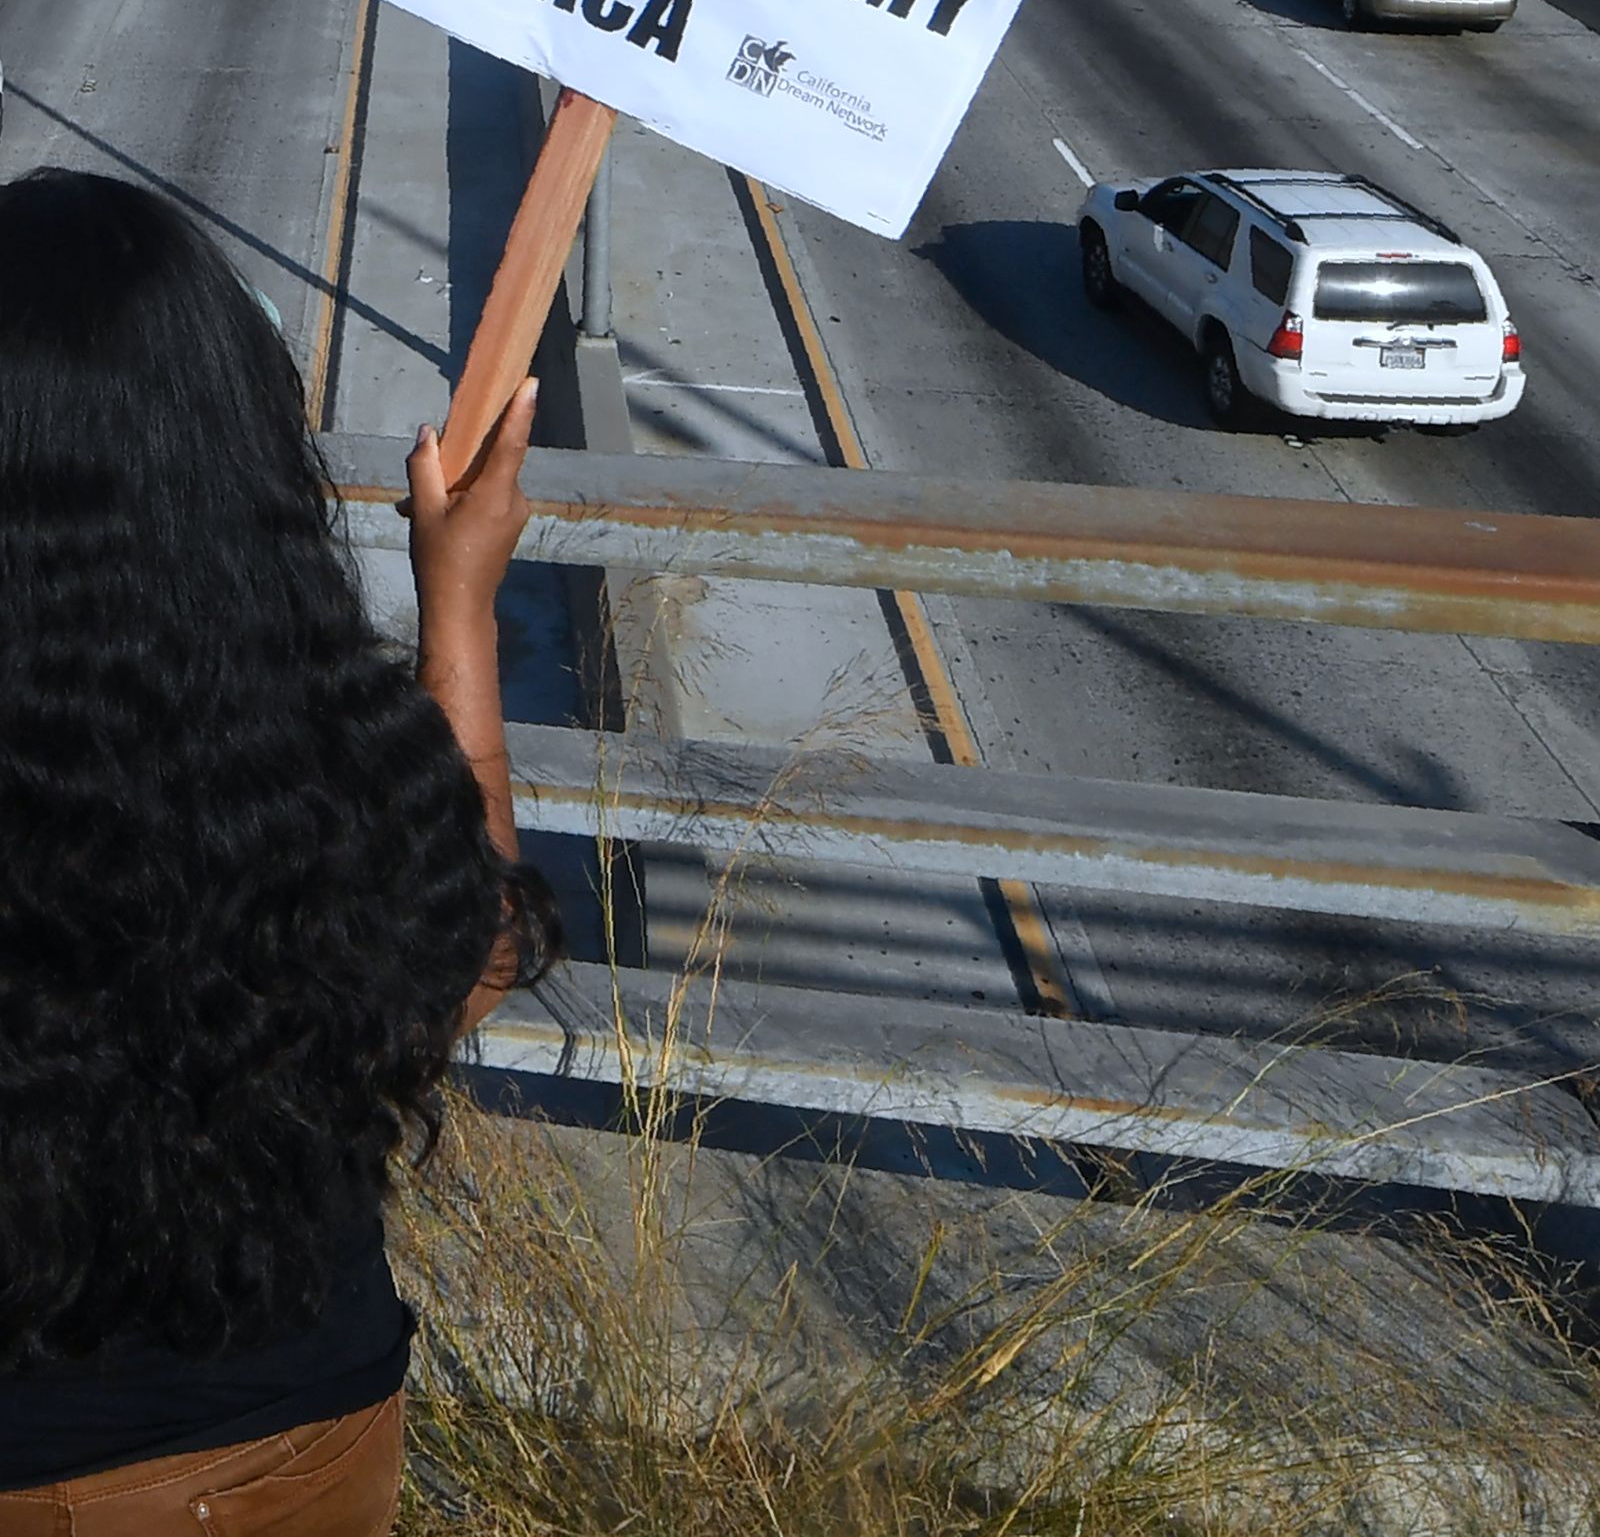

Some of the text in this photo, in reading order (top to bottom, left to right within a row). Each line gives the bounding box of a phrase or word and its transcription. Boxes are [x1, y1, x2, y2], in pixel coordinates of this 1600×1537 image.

[777, 78, 824, 109] Dream
[825, 100, 888, 138] Network
[797, 70, 872, 112] California
